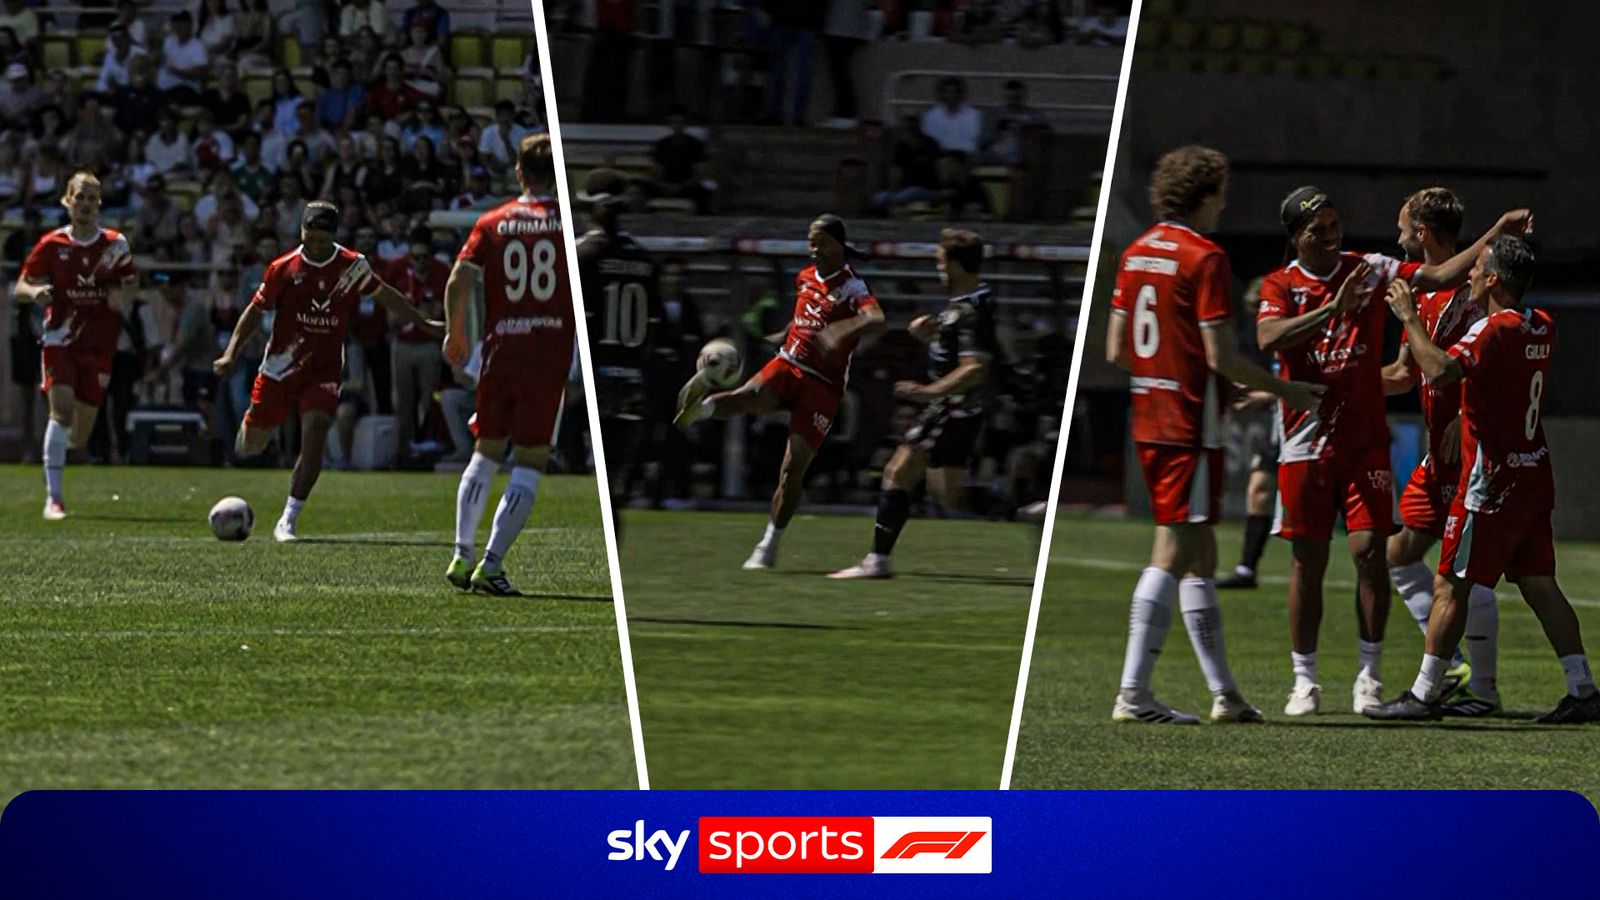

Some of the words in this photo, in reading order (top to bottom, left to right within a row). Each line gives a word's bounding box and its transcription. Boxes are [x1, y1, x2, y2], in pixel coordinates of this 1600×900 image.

[503, 238, 556, 303] 98
[598, 281, 648, 348] 10
[1132, 284, 1160, 360] 6
[1525, 369, 1543, 441] 8
